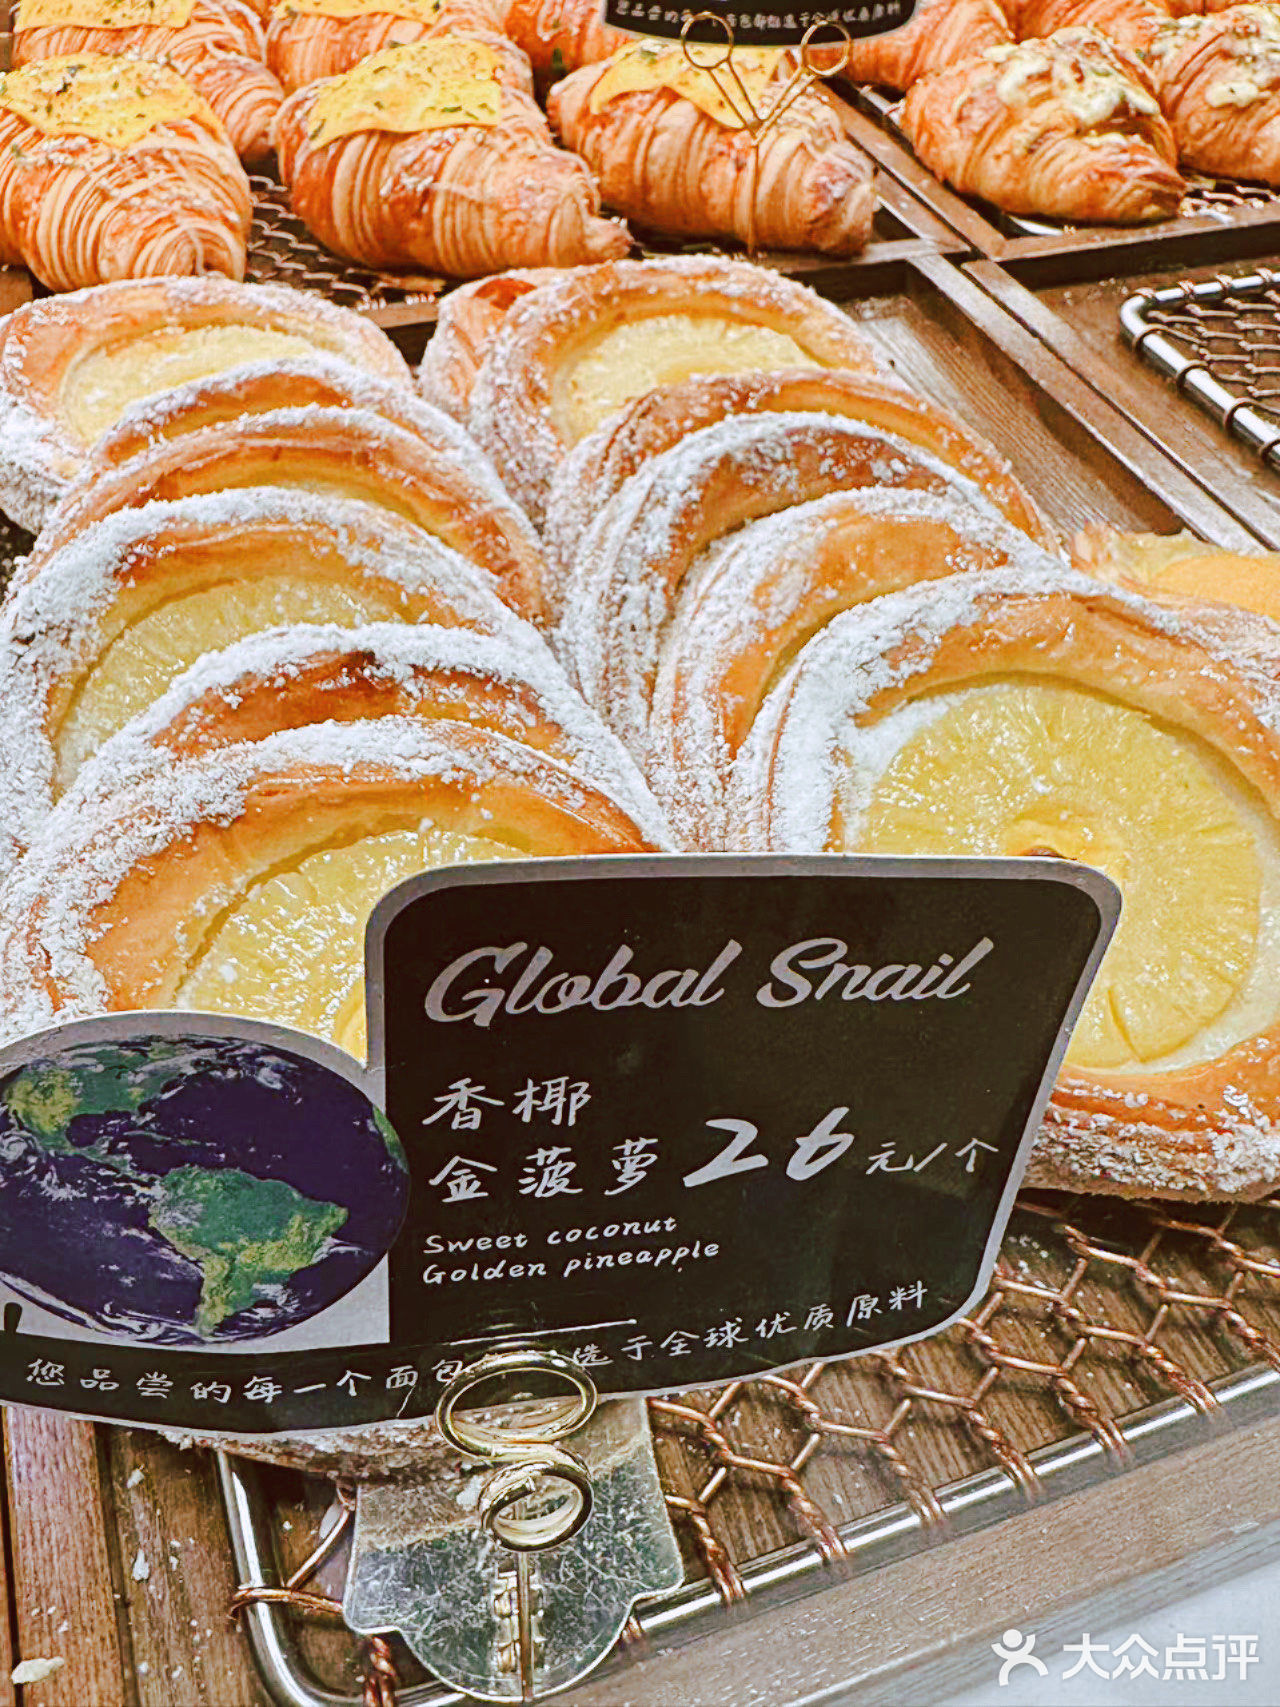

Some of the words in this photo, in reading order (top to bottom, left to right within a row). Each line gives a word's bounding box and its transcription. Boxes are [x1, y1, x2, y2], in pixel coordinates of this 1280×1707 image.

[424, 939, 743, 1027] Global
[756, 936, 994, 1008] Snail
[422, 1076, 592, 1131] 香椰
[428, 1136, 659, 1203] 金菠萝
[682, 1106, 855, 1188] 26
[422, 1259, 547, 1285] Golden
[563, 1239, 720, 1278] pineapple
[423, 1232, 528, 1254] Sweet
[546, 1216, 677, 1245] coconut
